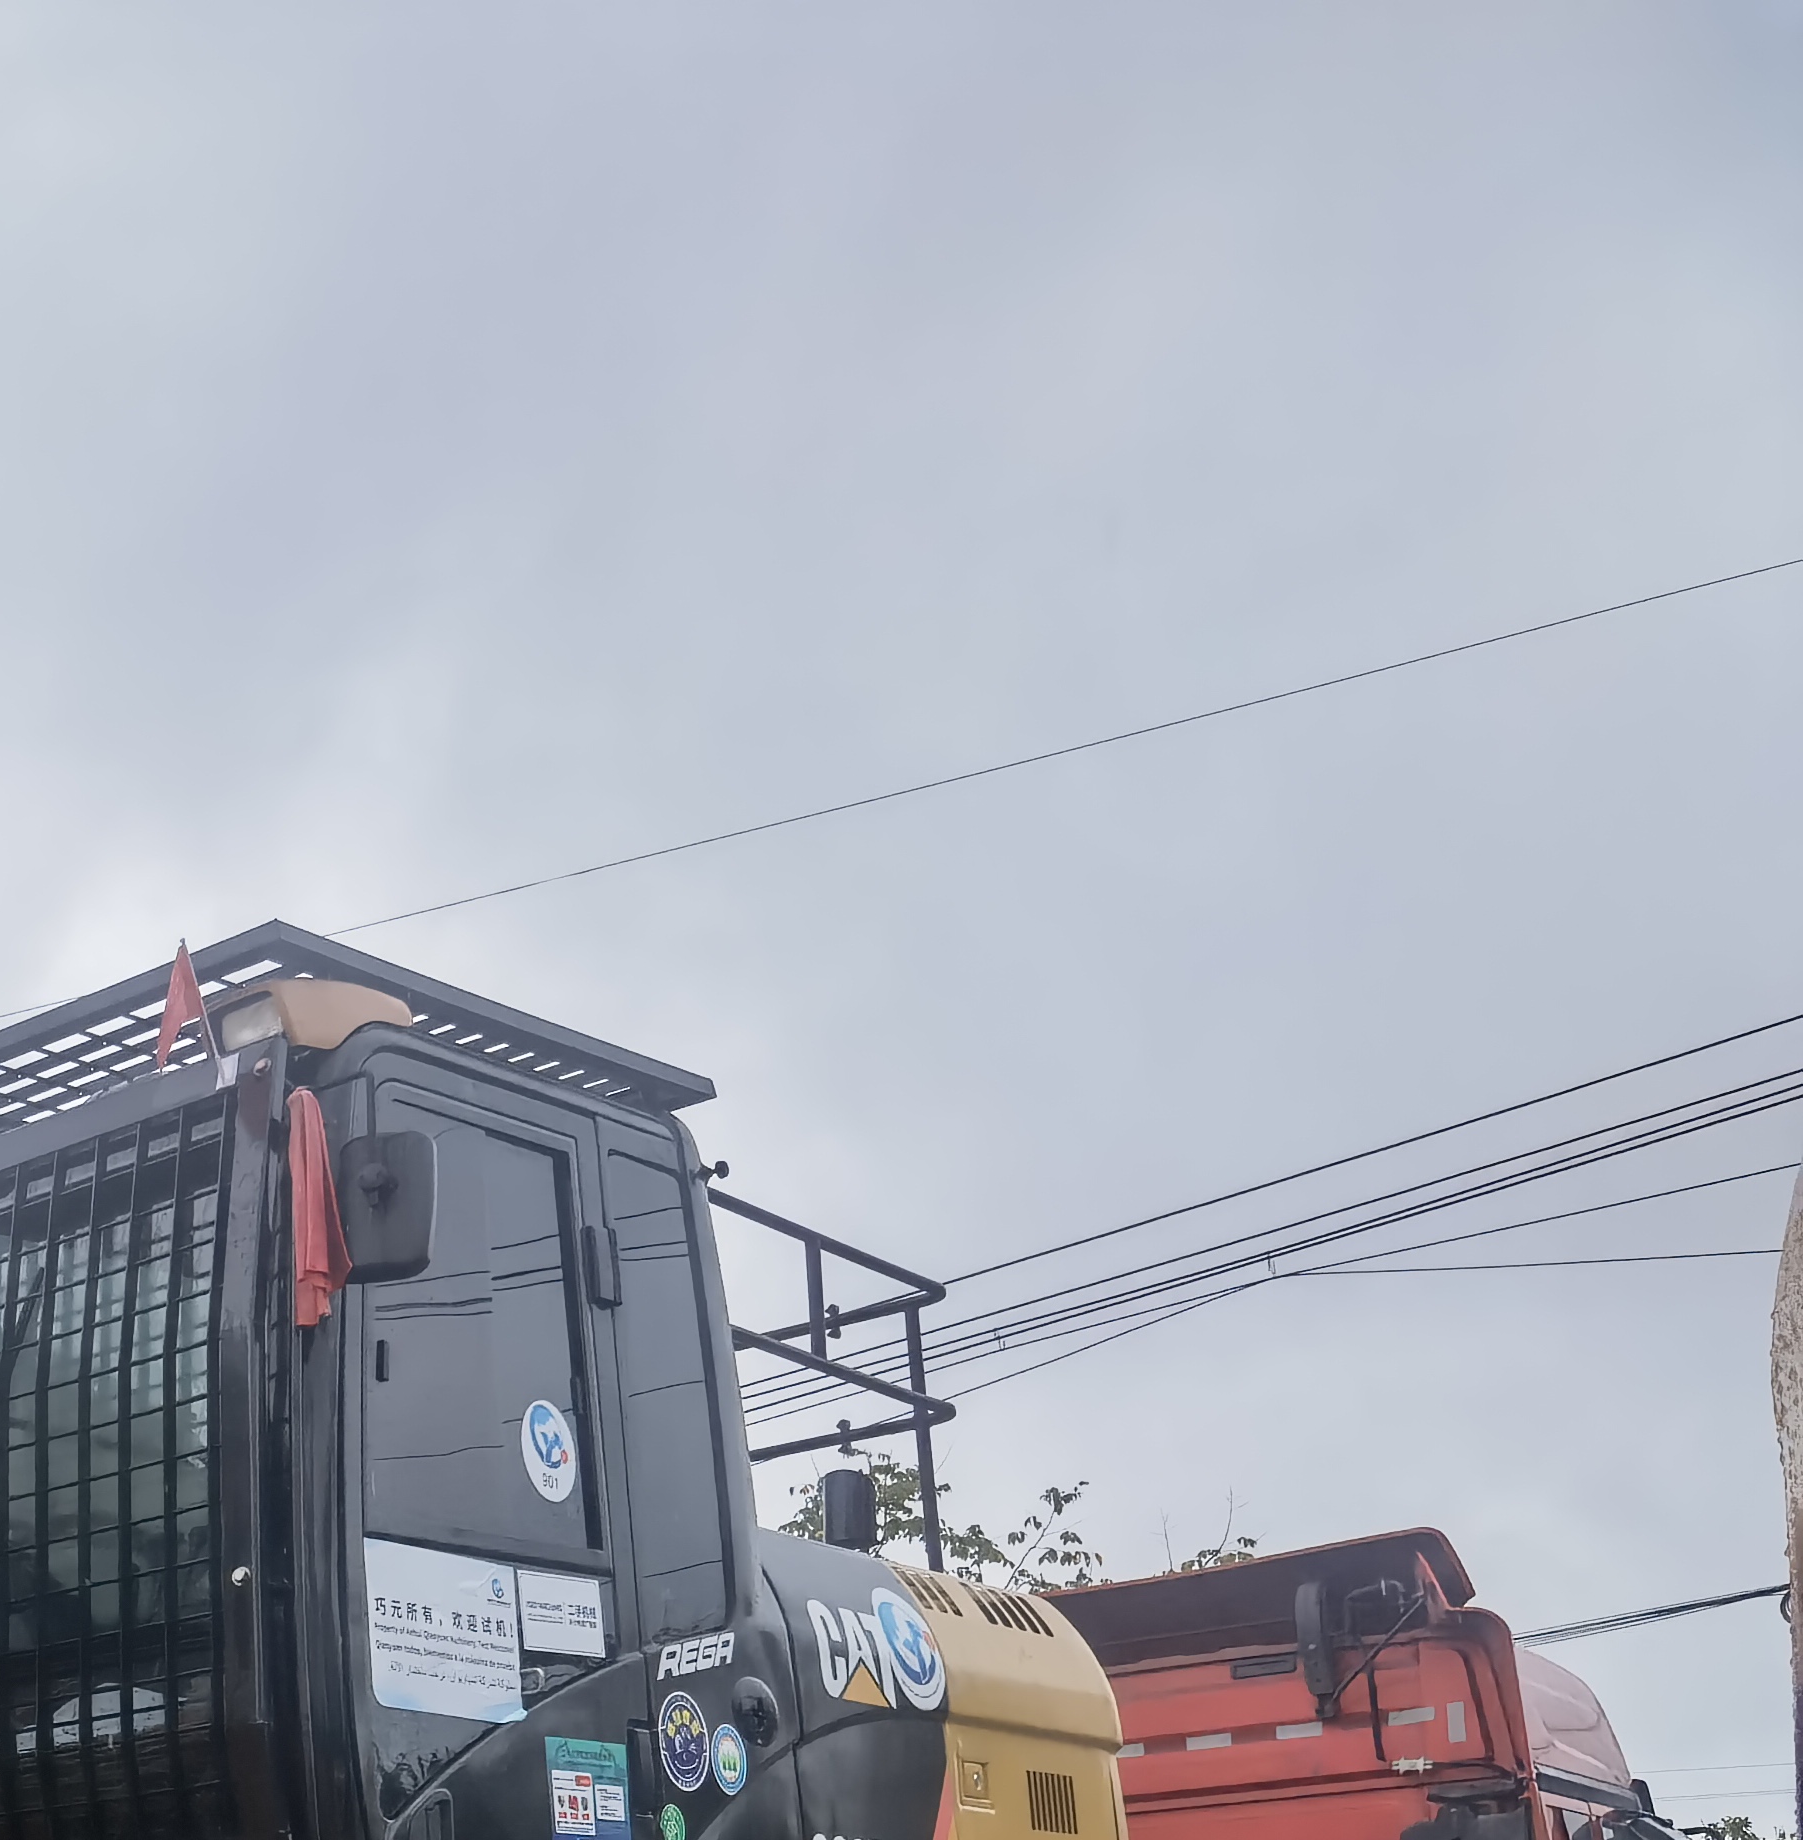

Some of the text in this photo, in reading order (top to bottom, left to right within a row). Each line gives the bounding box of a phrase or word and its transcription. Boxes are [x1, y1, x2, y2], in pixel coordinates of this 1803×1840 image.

[542, 1472, 559, 1489] 901
[657, 1632, 735, 1681] REGA
[807, 1600, 897, 1709] CAT
